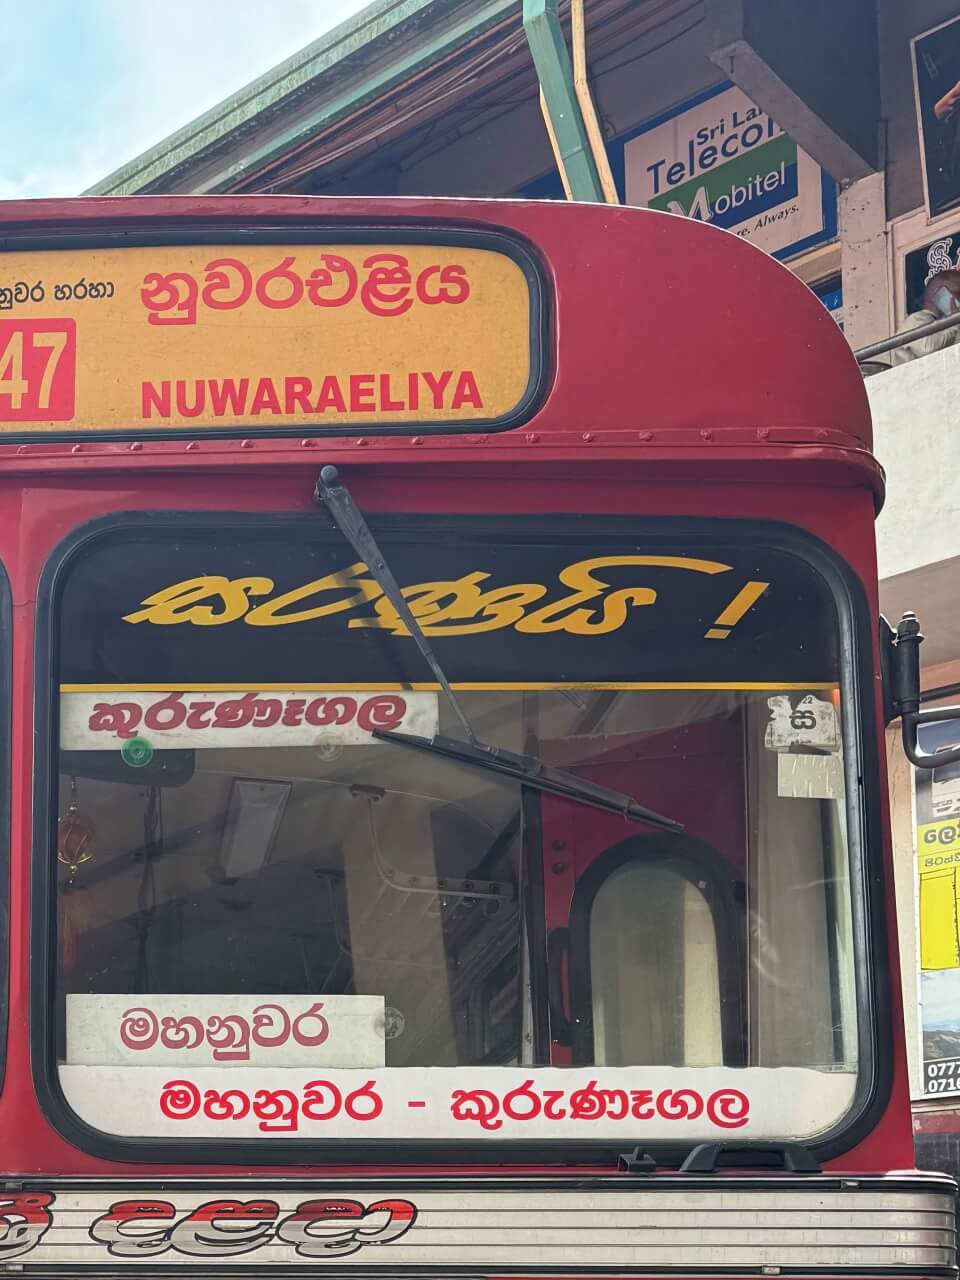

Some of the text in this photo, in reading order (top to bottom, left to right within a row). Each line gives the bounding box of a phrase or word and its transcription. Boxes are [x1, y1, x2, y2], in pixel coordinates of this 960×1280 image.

[697, 106, 763, 145] Sri La
[754, 205, 800, 231] Always.
[54, 278, 115, 301] හරහා
[141, 254, 470, 324] නුවරඑළිය
[142, 371, 483, 418] NUWARAELIYA
[88, 693, 407, 738] කුරුණෑගල
[119, 1002, 330, 1062] මහනුවර
[159, 1079, 384, 1133] මහනුවර
[450, 1079, 751, 1131] කුරුණෑගල
